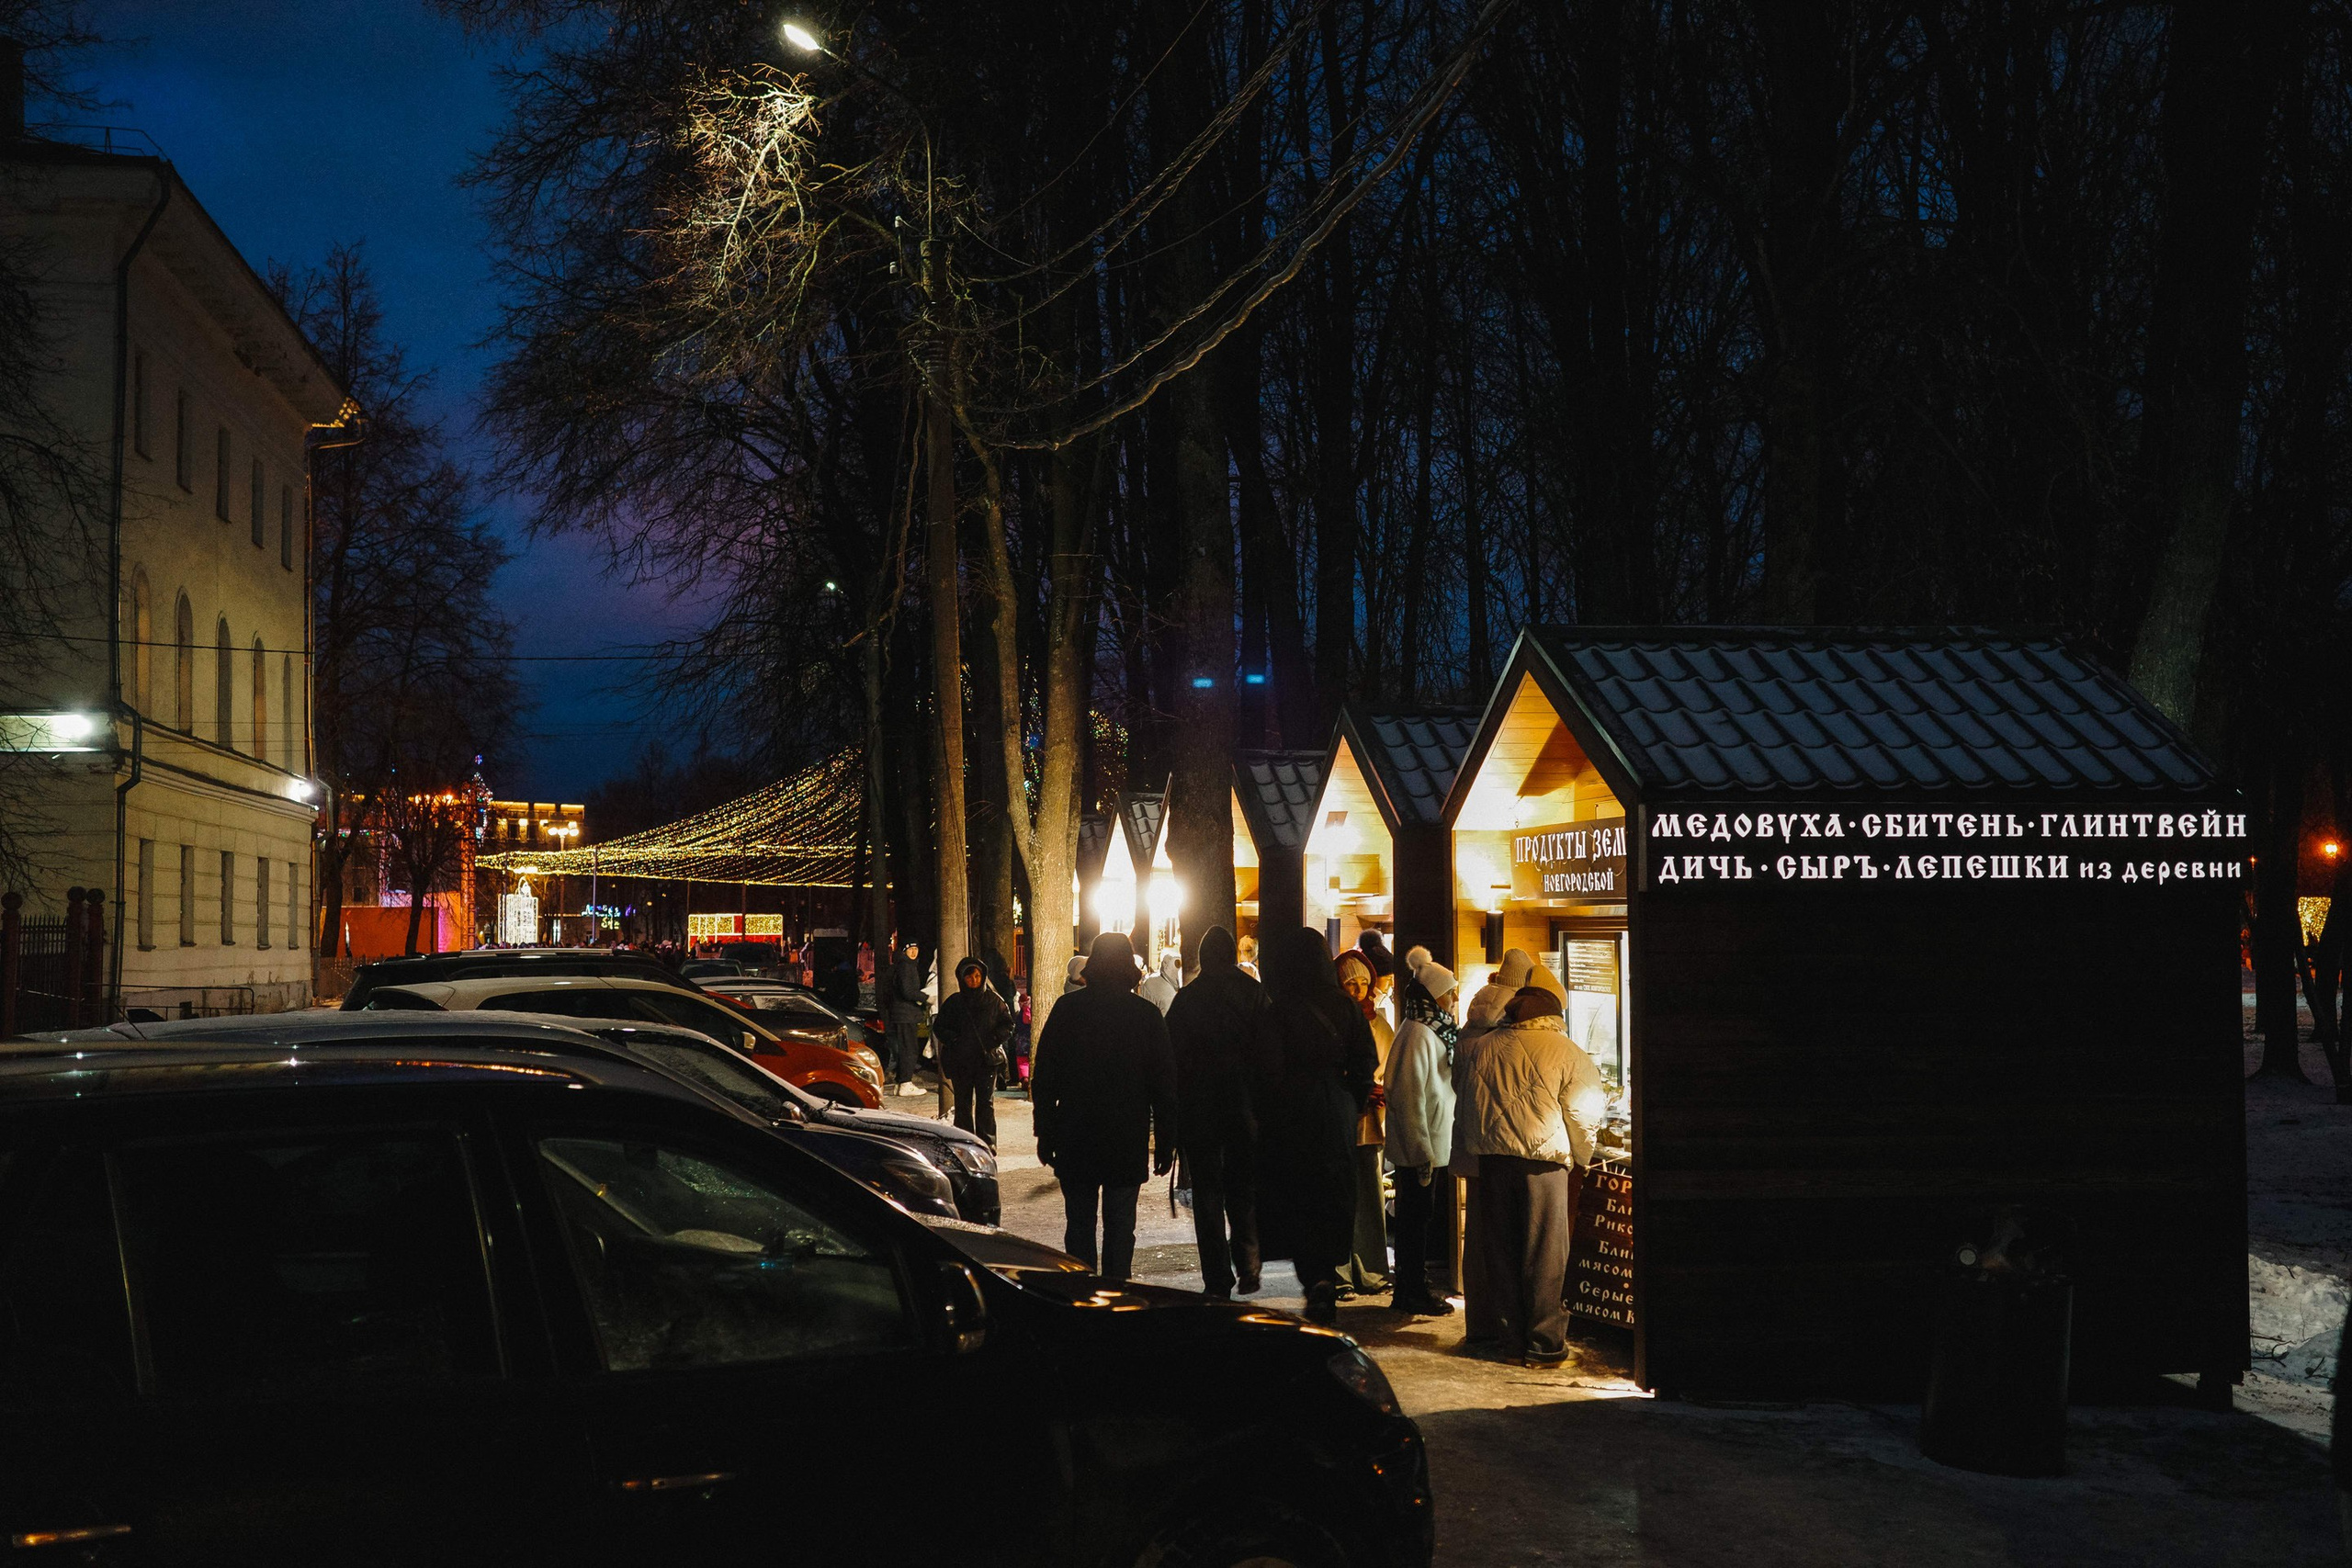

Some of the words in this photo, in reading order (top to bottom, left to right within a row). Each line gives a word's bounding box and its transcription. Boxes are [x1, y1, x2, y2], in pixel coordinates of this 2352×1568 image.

[1515, 830, 1587, 869] ПРОДУКТЫ
[1544, 868, 1614, 894] НОВГОРОДСКОЙ
[2079, 862, 2112, 880] из
[2121, 861, 2241, 886] деревни
[1599, 1240, 1634, 1260] Бли
[1578, 1258, 1633, 1279] мясом
[1579, 1280, 1634, 1305] Серые
[1573, 1302, 1621, 1321] мясом
